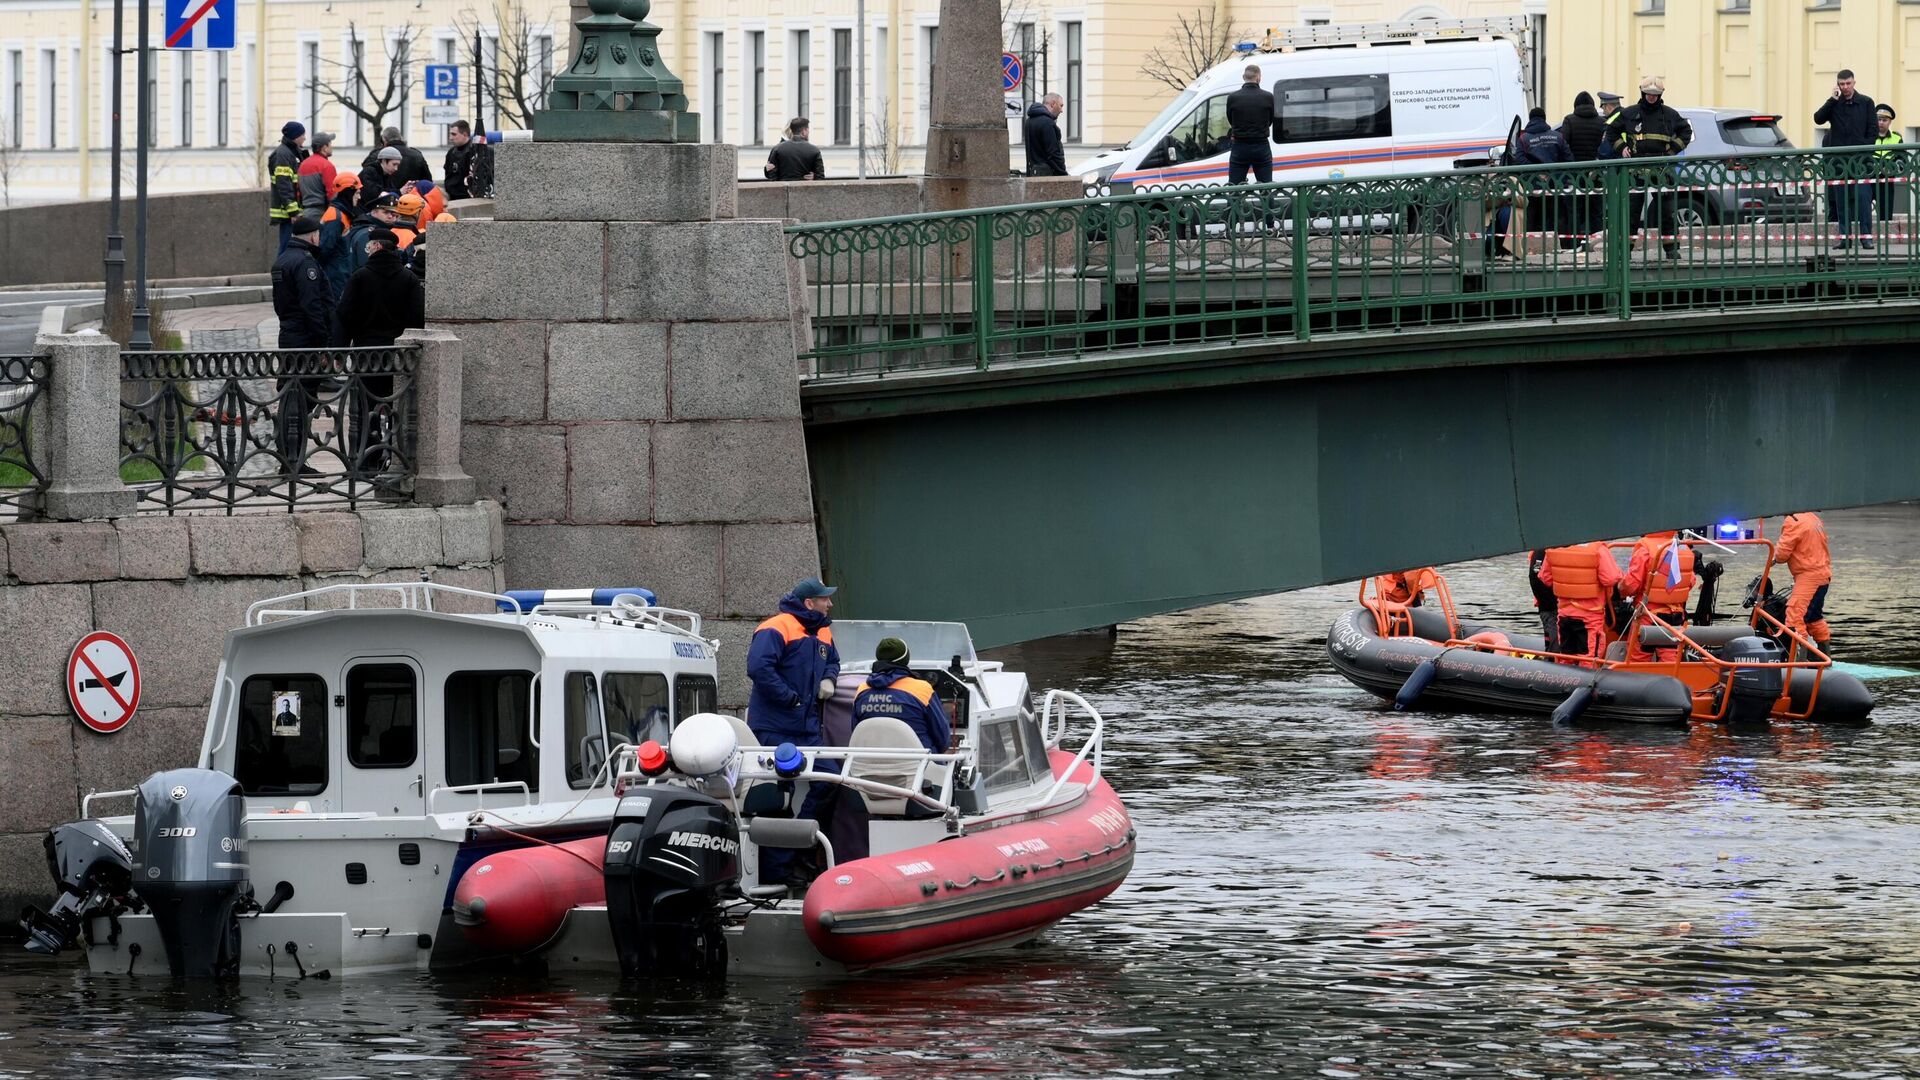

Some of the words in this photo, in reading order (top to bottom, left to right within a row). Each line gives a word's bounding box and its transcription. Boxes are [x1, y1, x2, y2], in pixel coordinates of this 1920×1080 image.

[433, 68, 453, 96] P
[1734, 656, 1760, 664] YAMAHA
[1474, 663, 1506, 678] служба
[1505, 666, 1581, 686] Санкт-Петербурга
[868, 694, 893, 703] МЧС
[860, 703, 903, 713] РОССИИ
[157, 826, 198, 838] 300
[608, 841, 633, 853] 150
[667, 831, 740, 856] MERCURY
